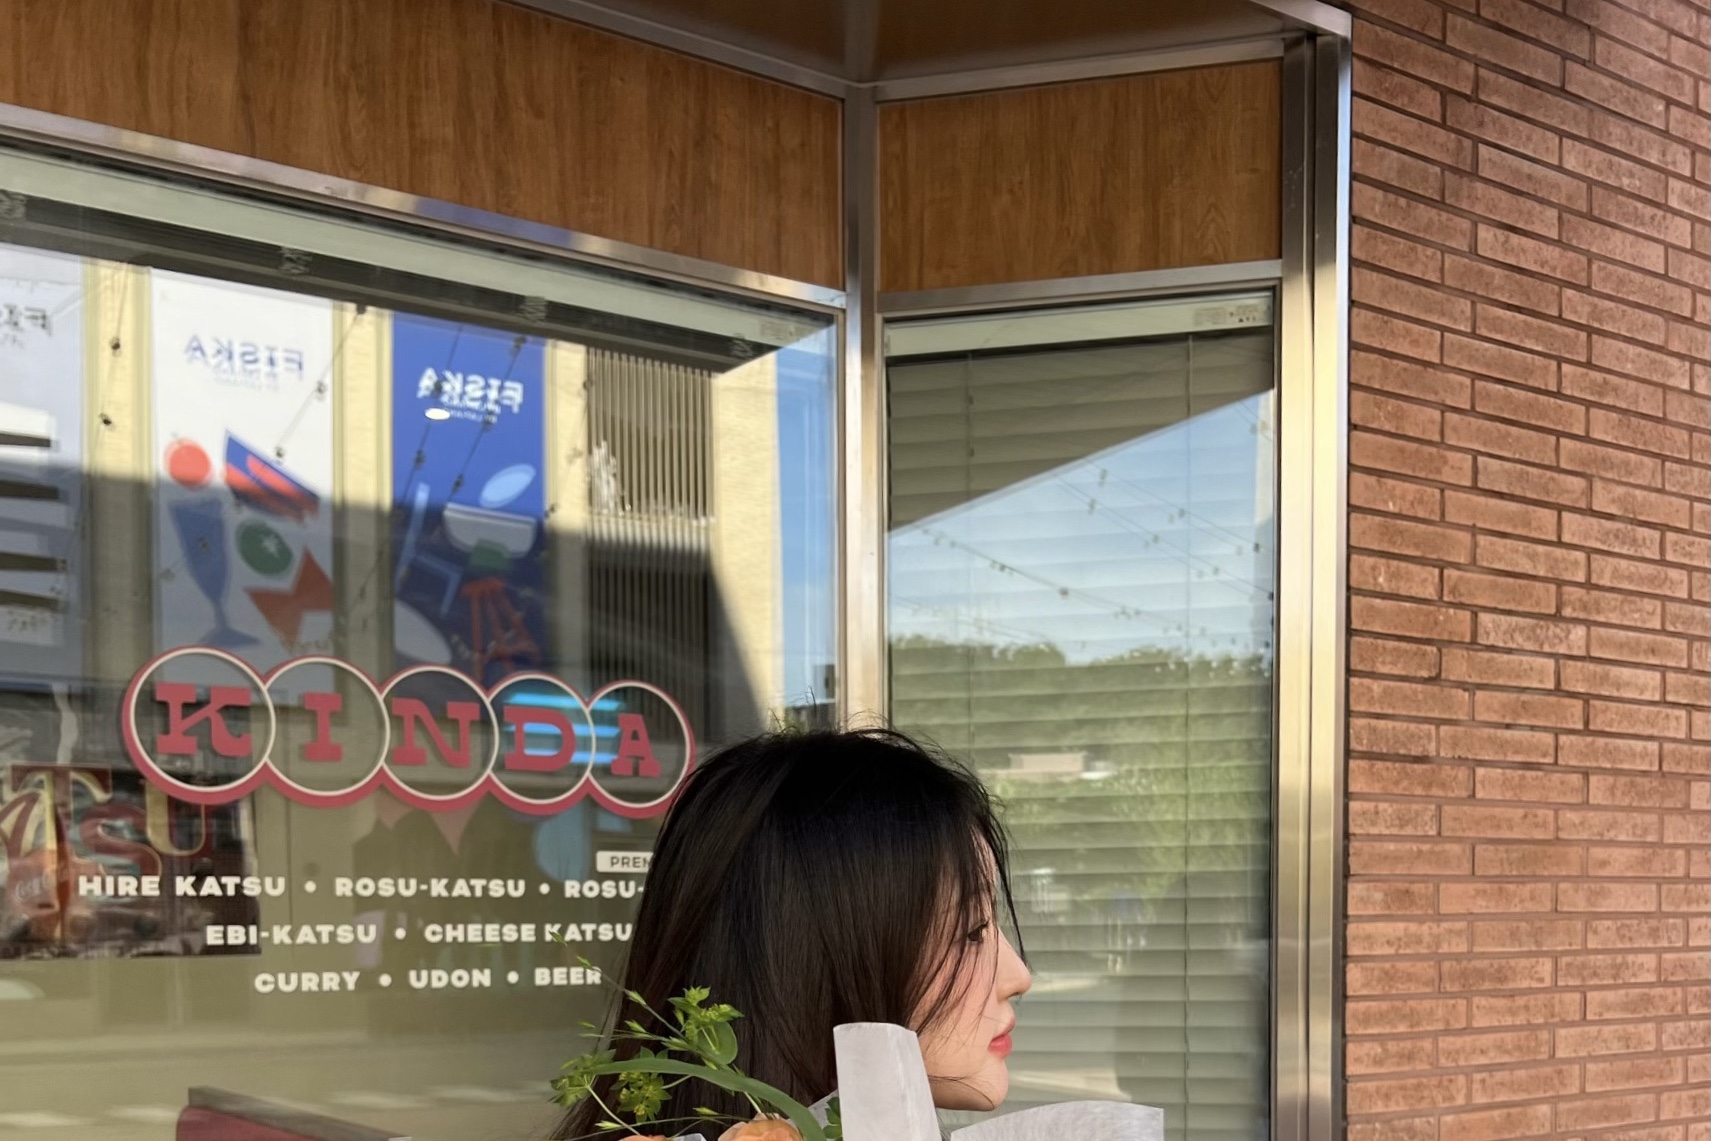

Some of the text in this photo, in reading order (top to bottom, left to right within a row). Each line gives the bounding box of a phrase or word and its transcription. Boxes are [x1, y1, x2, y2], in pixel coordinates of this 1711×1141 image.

[155, 682, 661, 778] KINDA
[78, 875, 161, 897] HIRE
[175, 875, 286, 897] KATSU
[334, 877, 526, 898] ROSU-KATSU
[205, 923, 633, 945] EBI-KATSU CHEESE KATSU
[254, 967, 602, 993] CURRY UDON BEER
